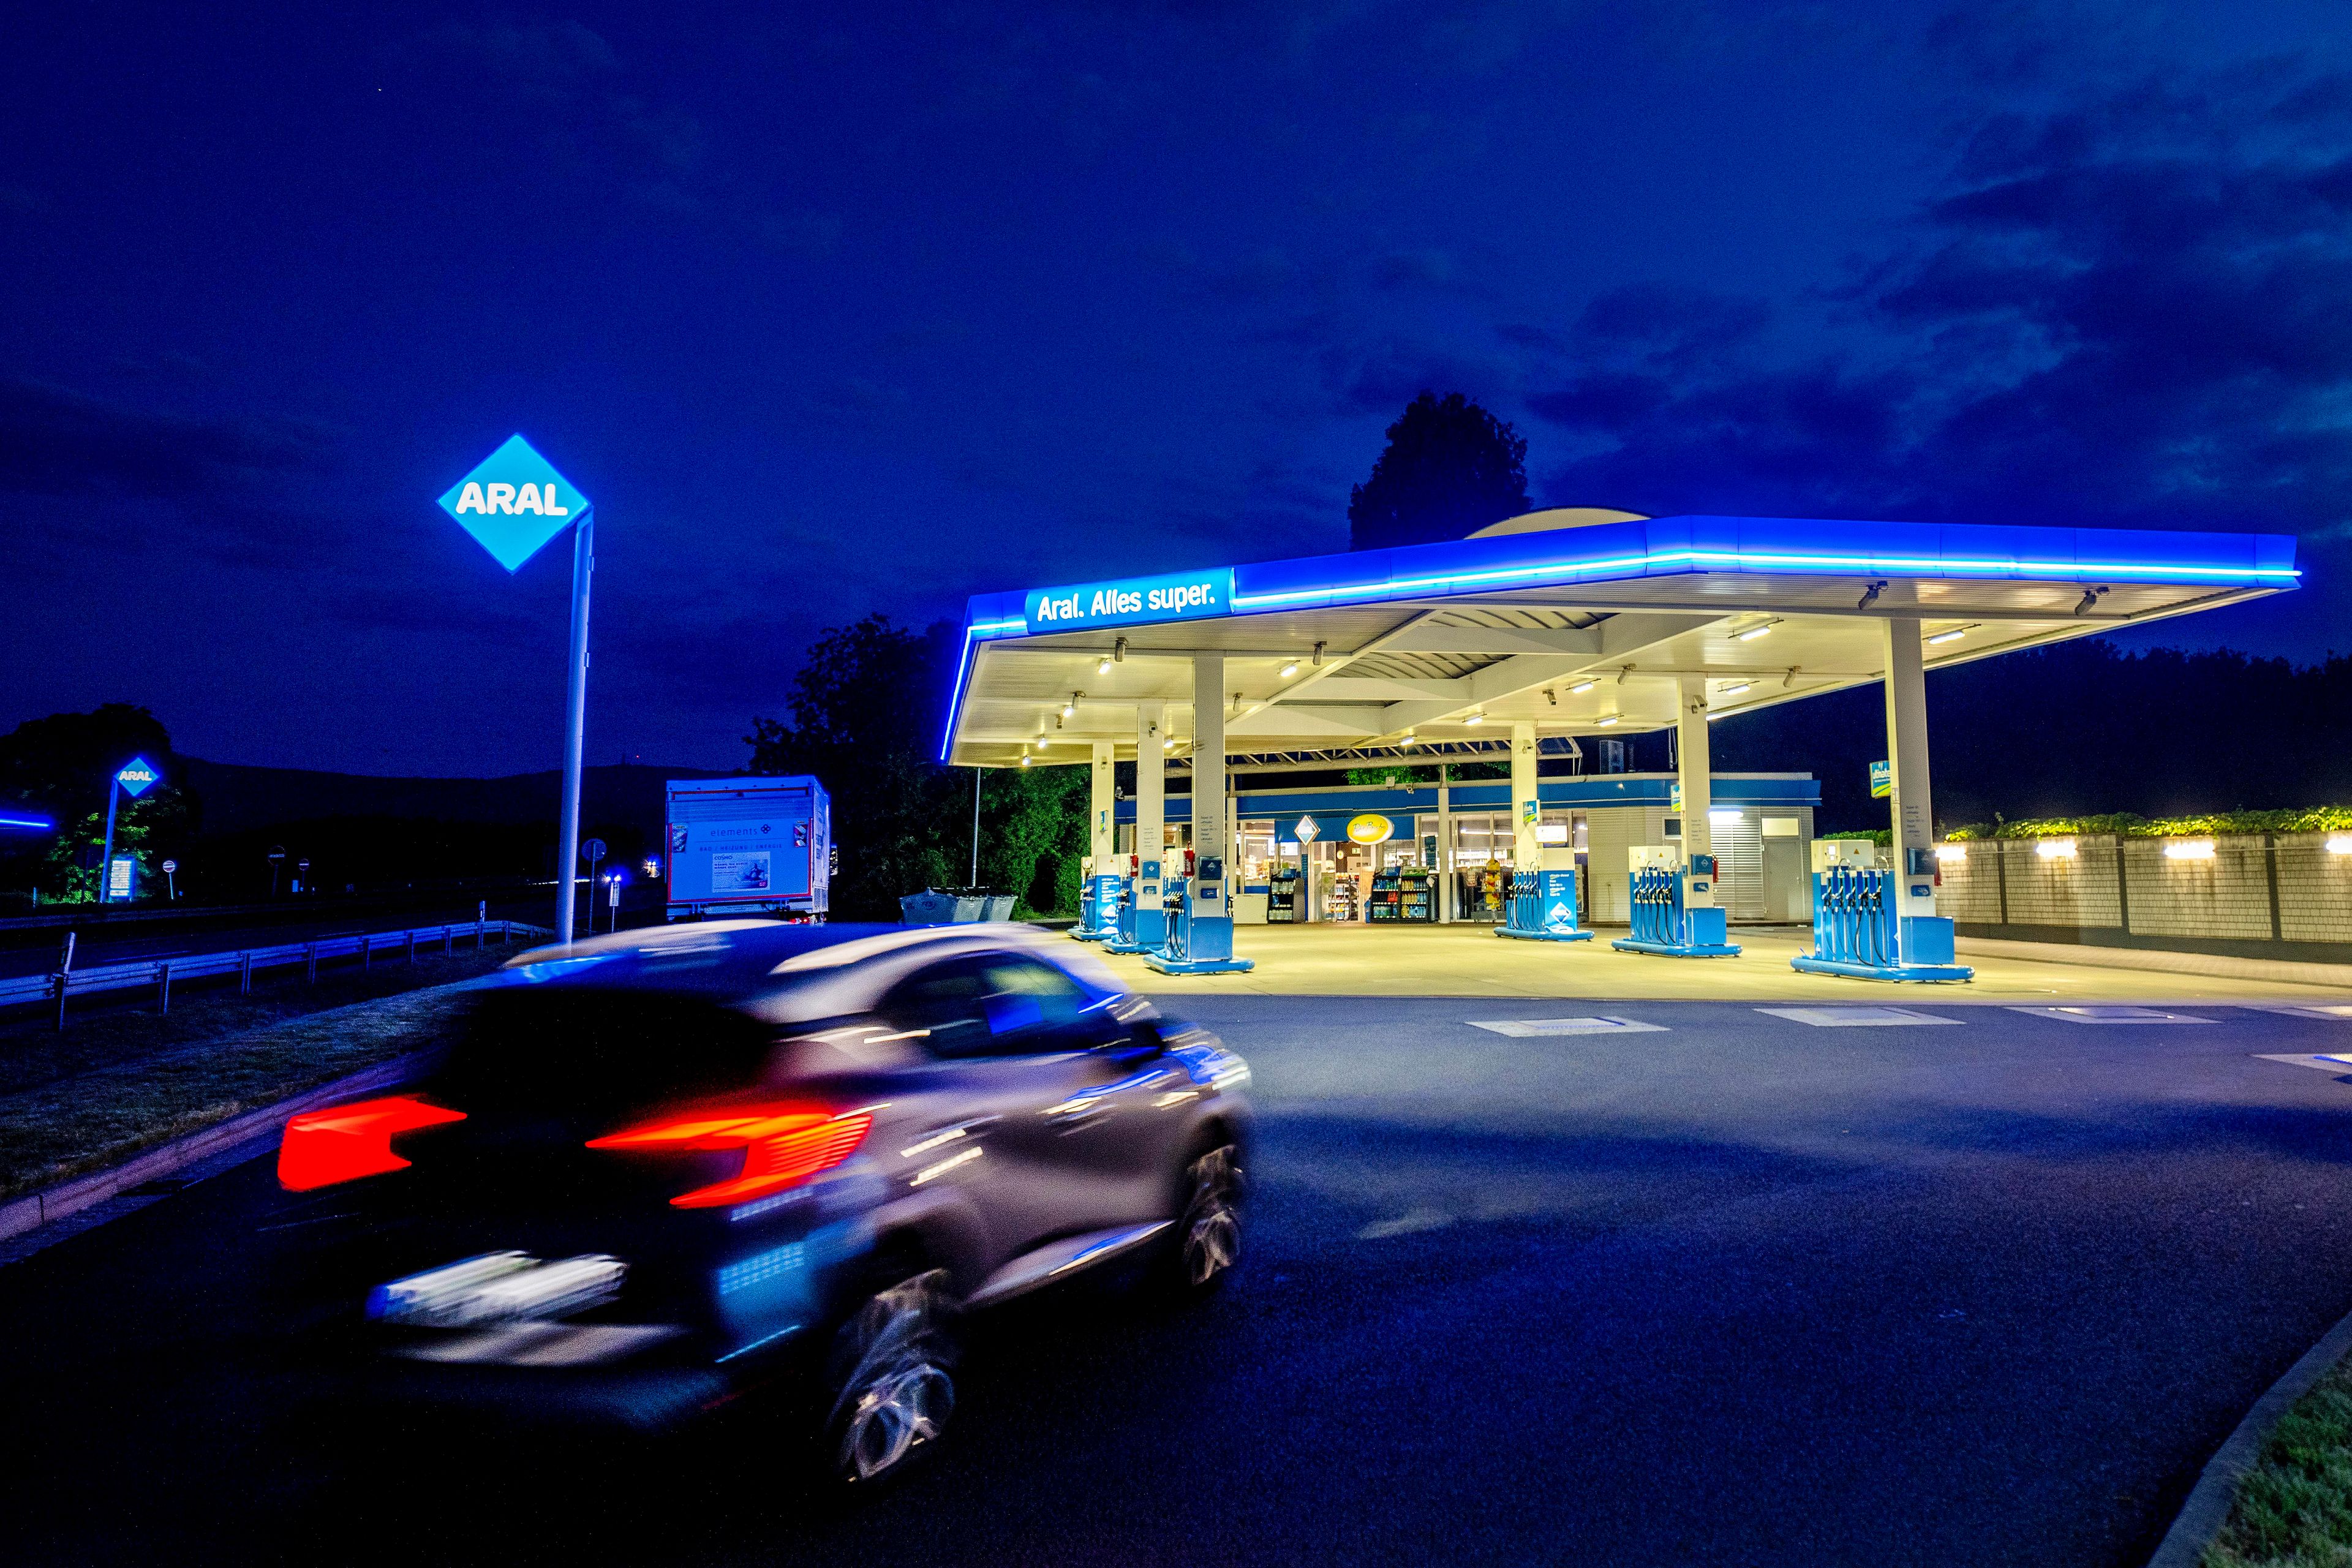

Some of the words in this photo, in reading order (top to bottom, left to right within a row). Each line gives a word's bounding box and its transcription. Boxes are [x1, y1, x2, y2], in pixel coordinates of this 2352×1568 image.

[455, 481, 568, 516] ARAL
[1037, 592, 1085, 622] Aral.
[1090, 589, 1142, 617] Alles
[1147, 582, 1216, 613] super.
[118, 771, 153, 782] ARAL
[710, 828, 758, 837] elements
